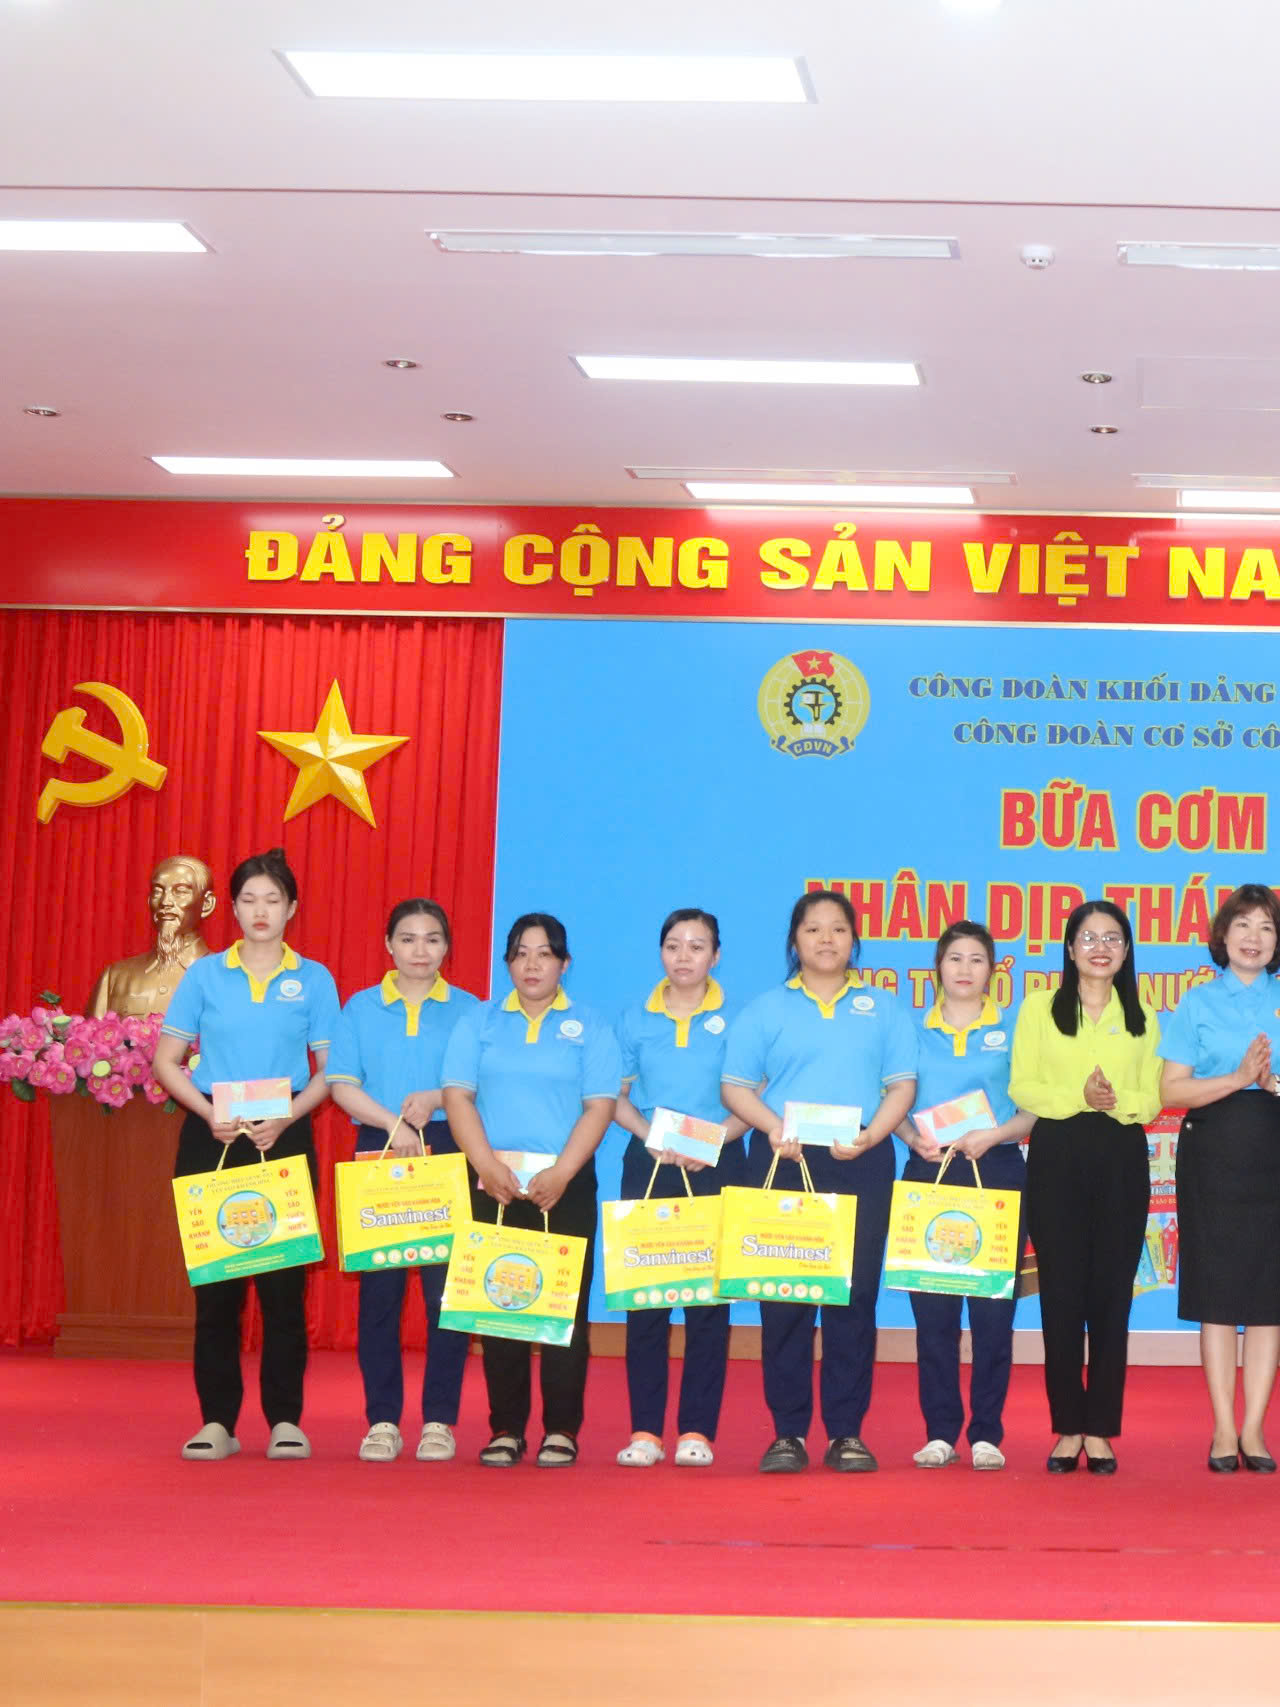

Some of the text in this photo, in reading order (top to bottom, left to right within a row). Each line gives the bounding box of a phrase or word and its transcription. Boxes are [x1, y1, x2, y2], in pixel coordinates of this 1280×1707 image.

[245, 513, 473, 584] ĐẢNG
[503, 523, 729, 596] CỘNG
[759, 522, 932, 592] SẢN
[962, 531, 1139, 606] VIỆT
[909, 672, 992, 698] CÔNG
[1096, 672, 1180, 702] KHỐI
[953, 717, 1038, 745] CÔNG
[1143, 722, 1185, 748] CƠ
[1192, 720, 1234, 749] SỞ
[1001, 777, 1120, 852] BỮA
[1136, 786, 1268, 855] CƠM
[360, 1205, 451, 1229] Sanvinest
[624, 1246, 713, 1267] Sanvinest
[742, 1234, 831, 1261] Sanvinest
